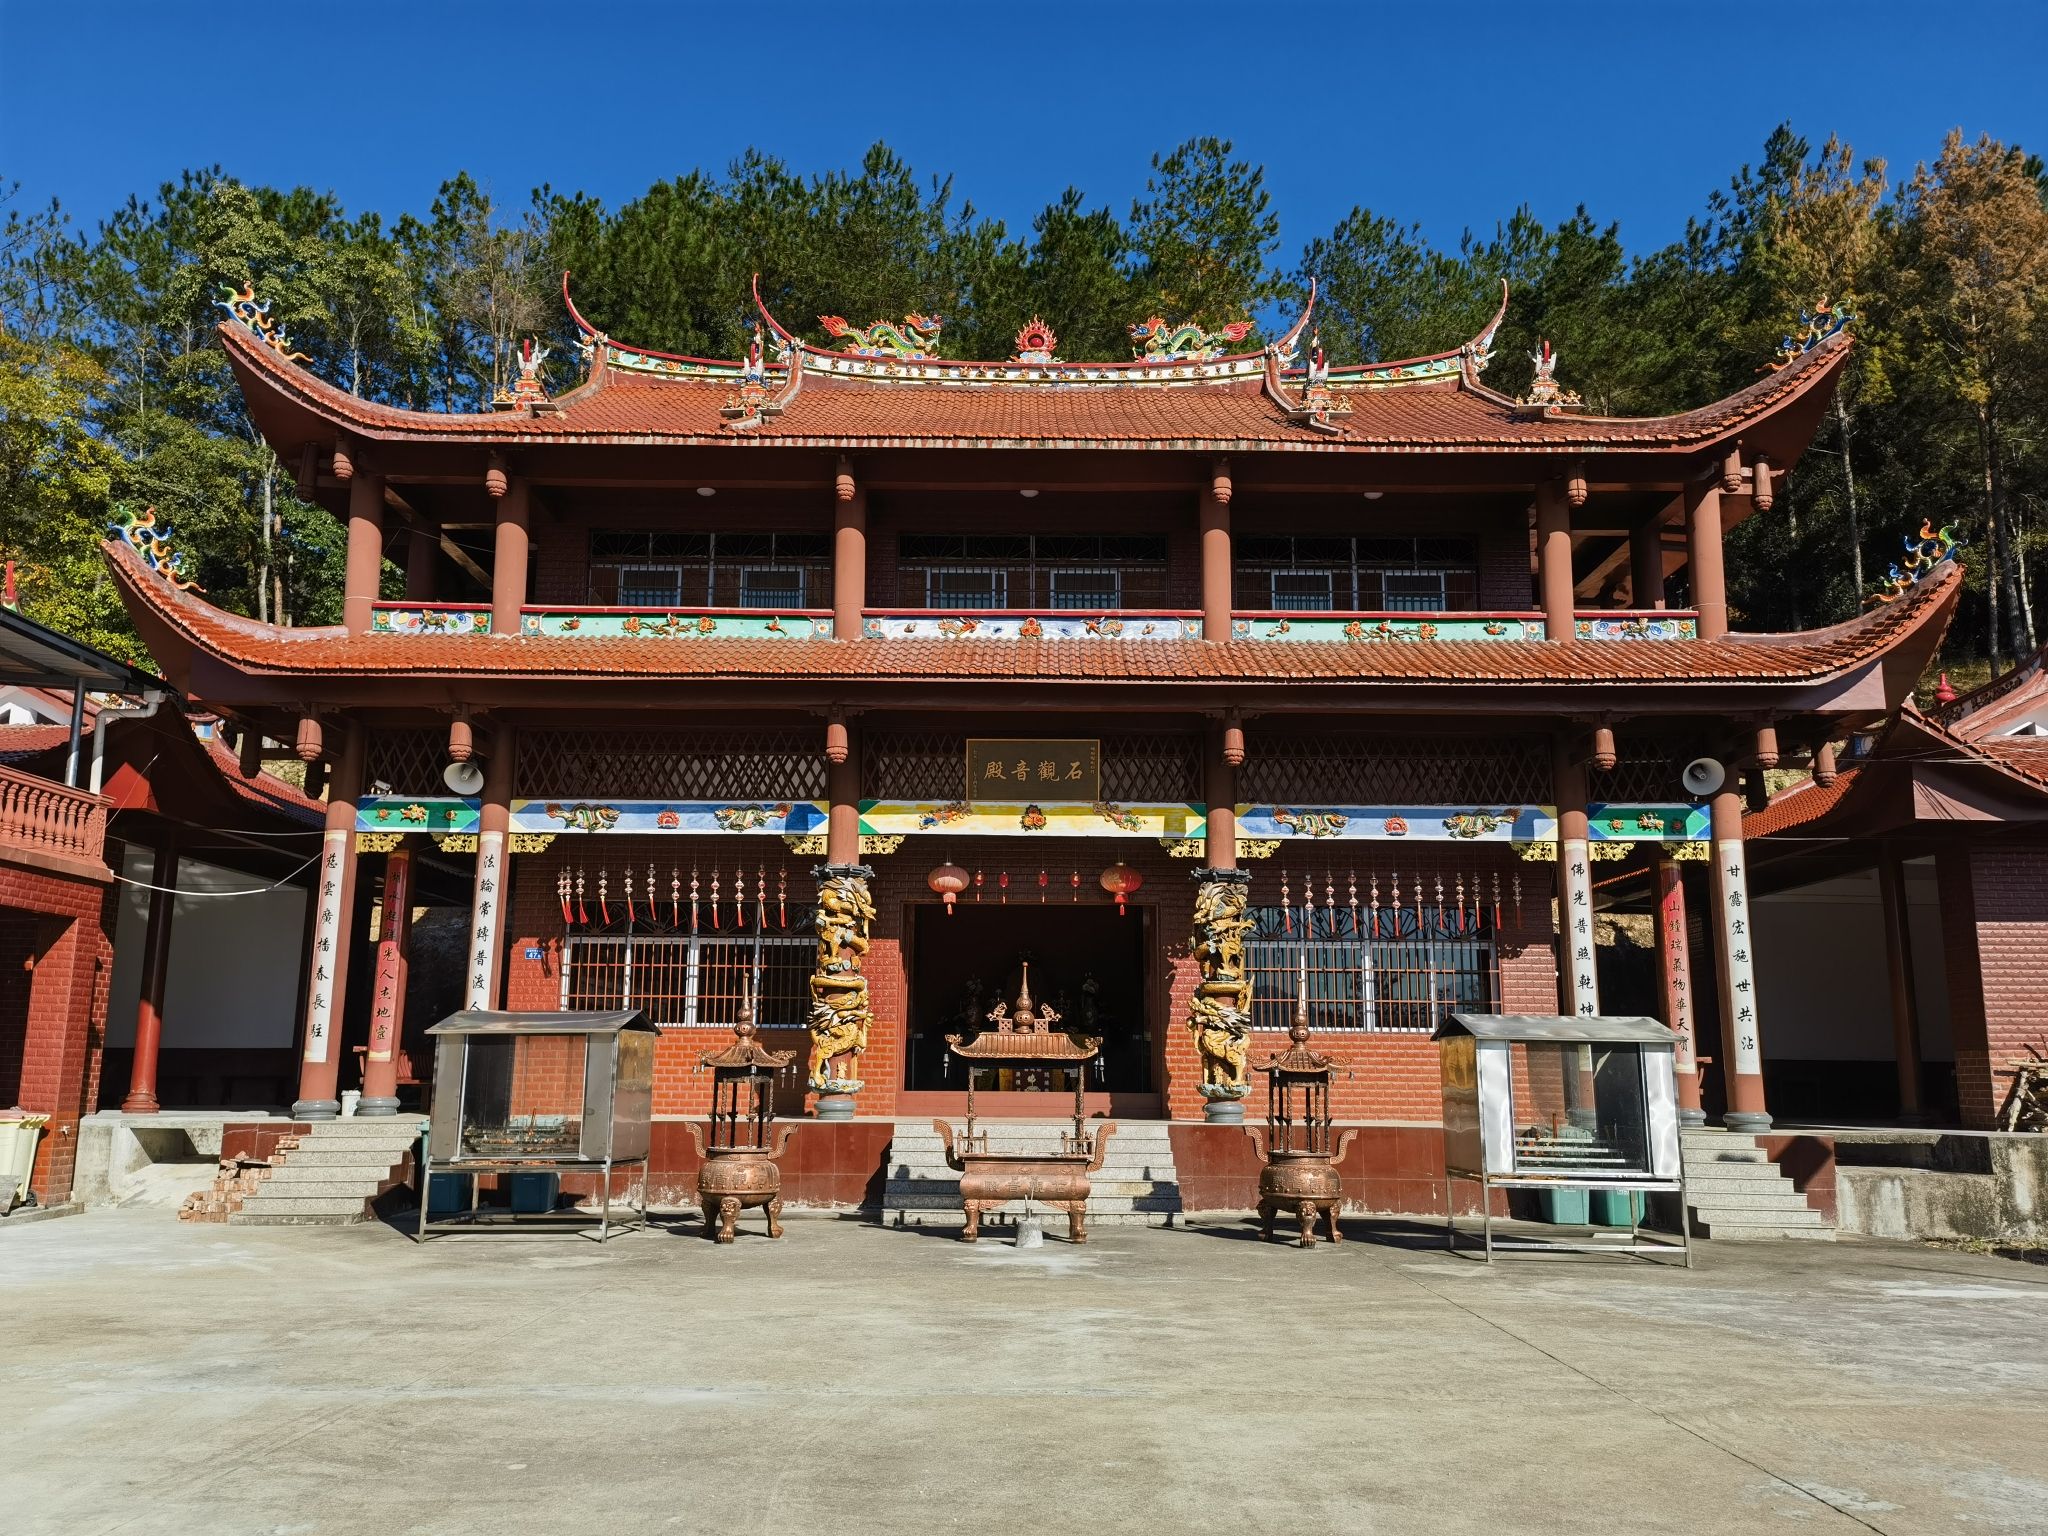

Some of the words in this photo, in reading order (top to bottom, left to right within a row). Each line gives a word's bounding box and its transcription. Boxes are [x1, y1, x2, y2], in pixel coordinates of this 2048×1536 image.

[983, 760, 1084, 782] 石觀音殿
[310, 853, 338, 1039] 慈雲廣播春長駐
[470, 855, 495, 1010] 法輪常轉普渡人
[1571, 862, 1594, 1017] 佛光普照乾坤
[1726, 864, 1754, 1051] 甘露宏施世共沾
